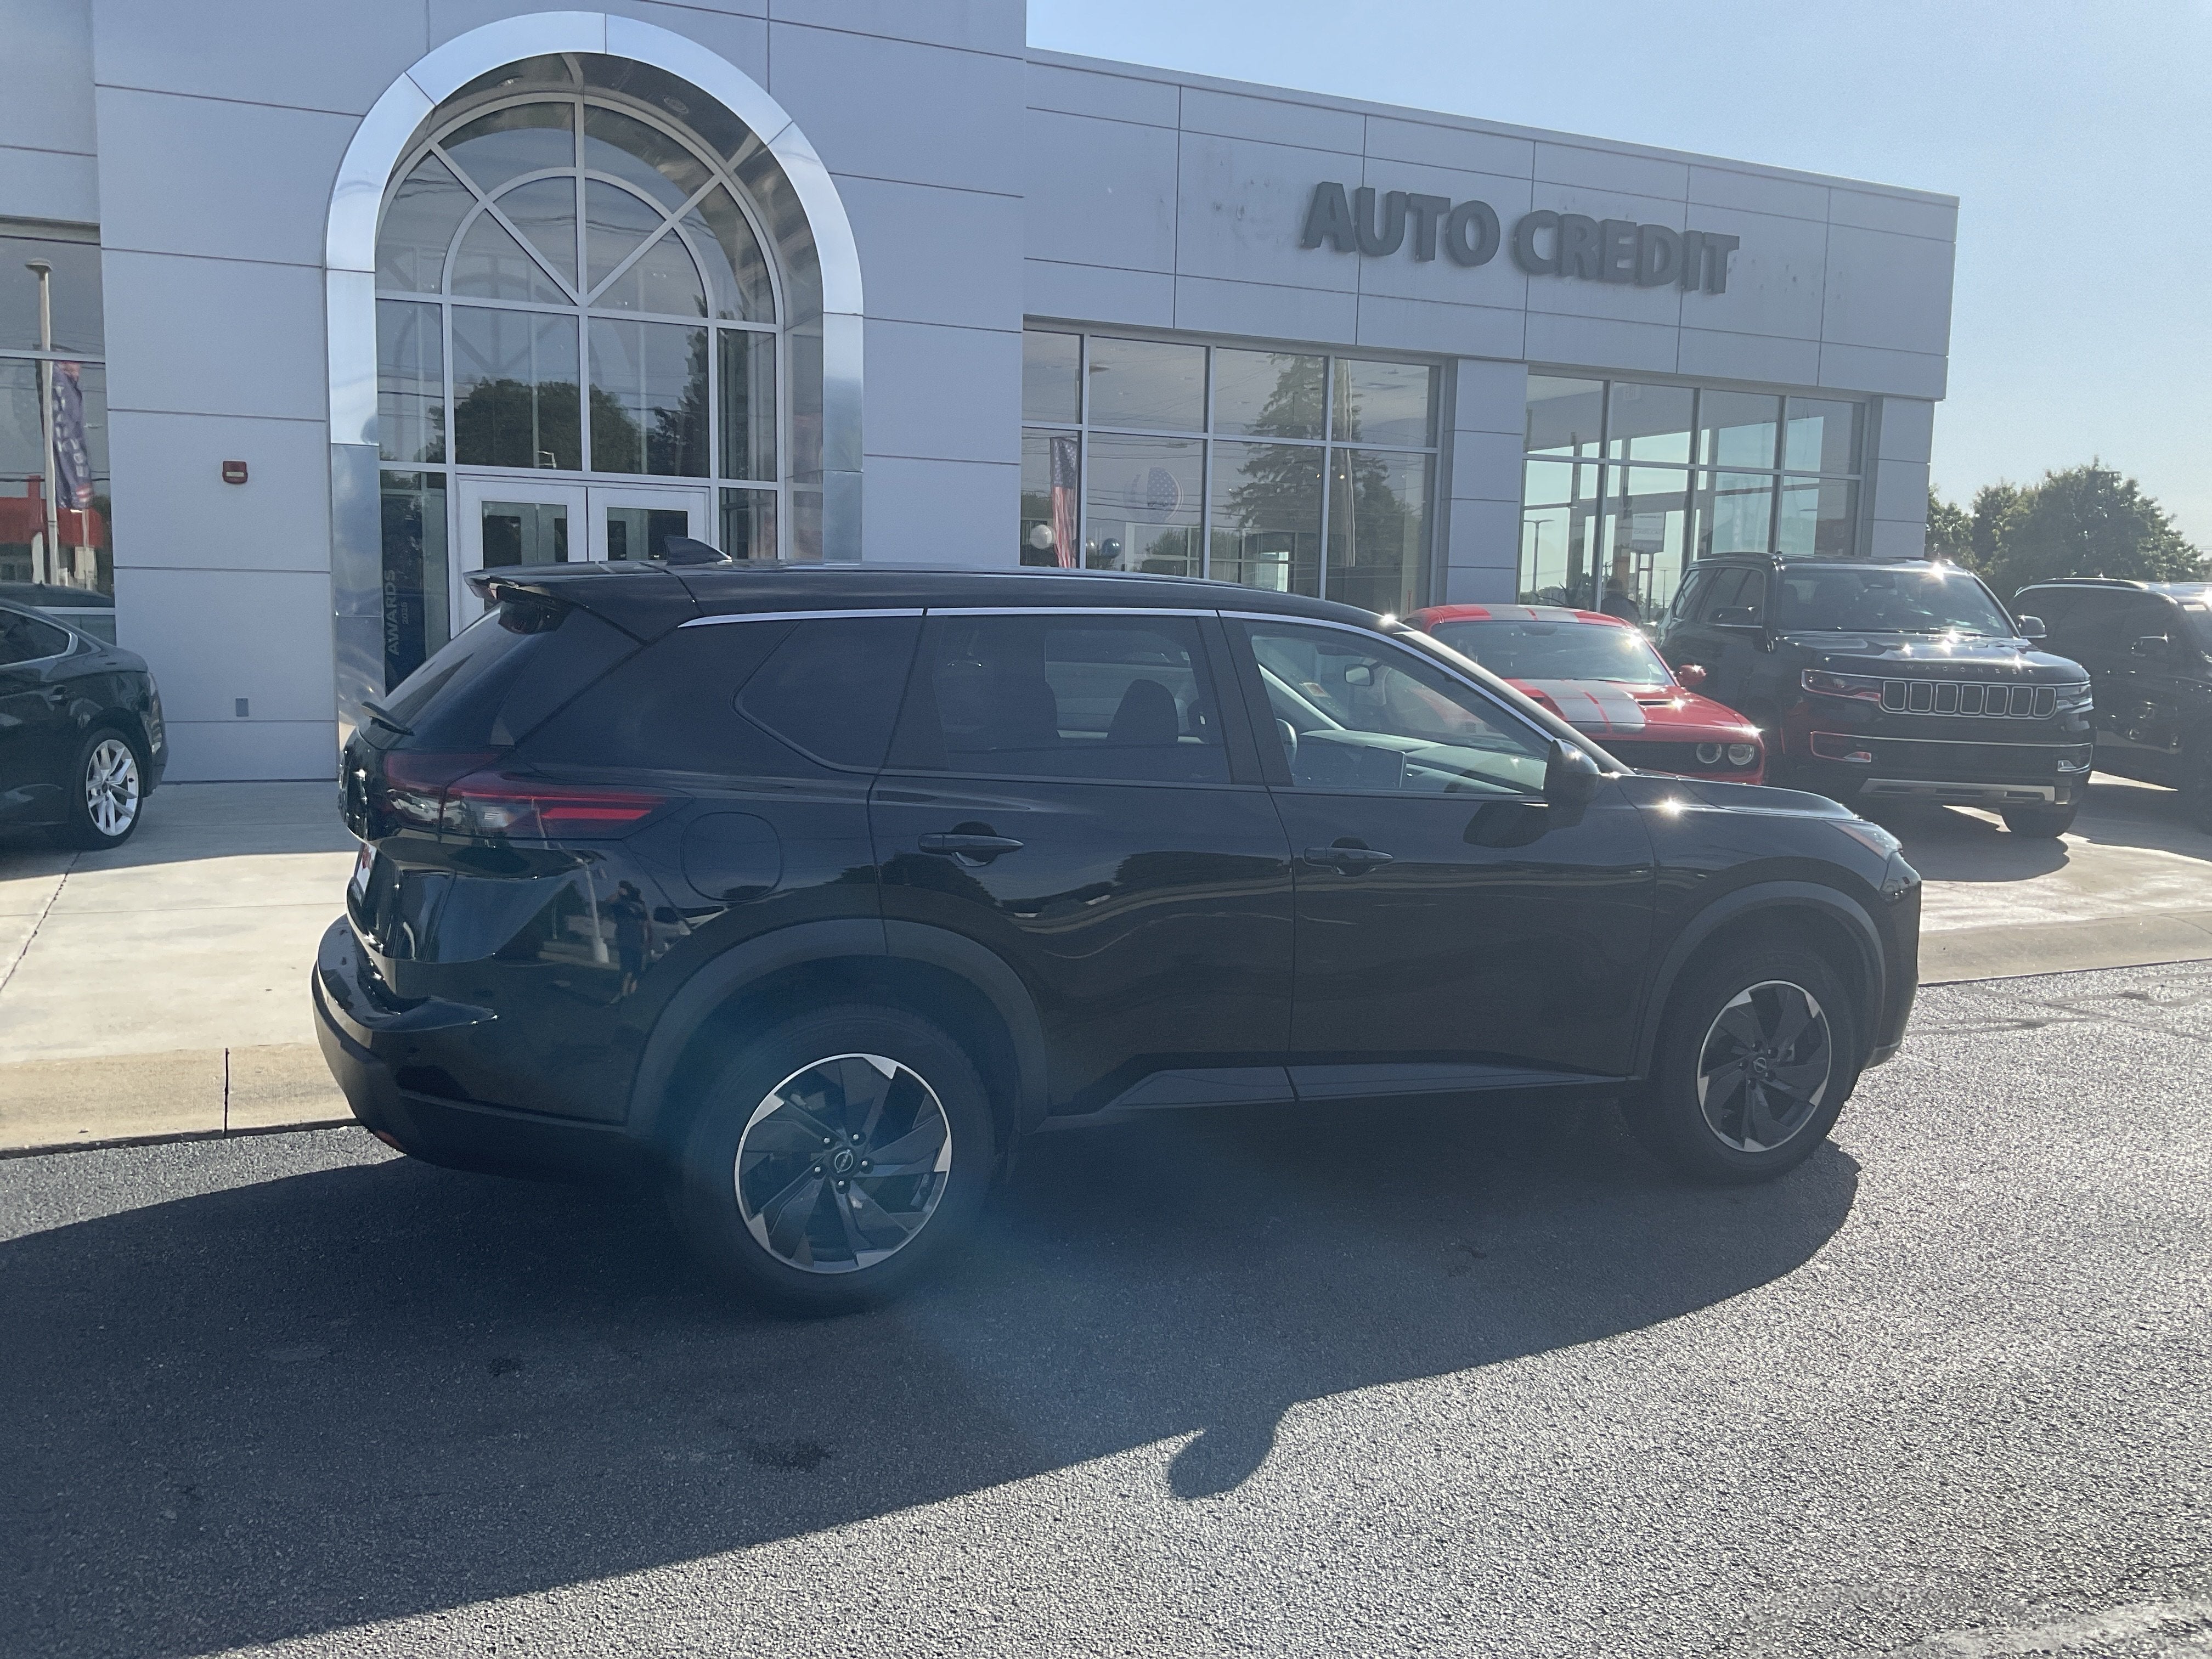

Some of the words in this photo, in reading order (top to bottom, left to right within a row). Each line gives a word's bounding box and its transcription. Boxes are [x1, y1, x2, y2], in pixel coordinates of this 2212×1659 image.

[1302, 182, 1500, 267] AUTO
[1513, 210, 1740, 294] CREDIT
[385, 569, 399, 656] AWARDS
